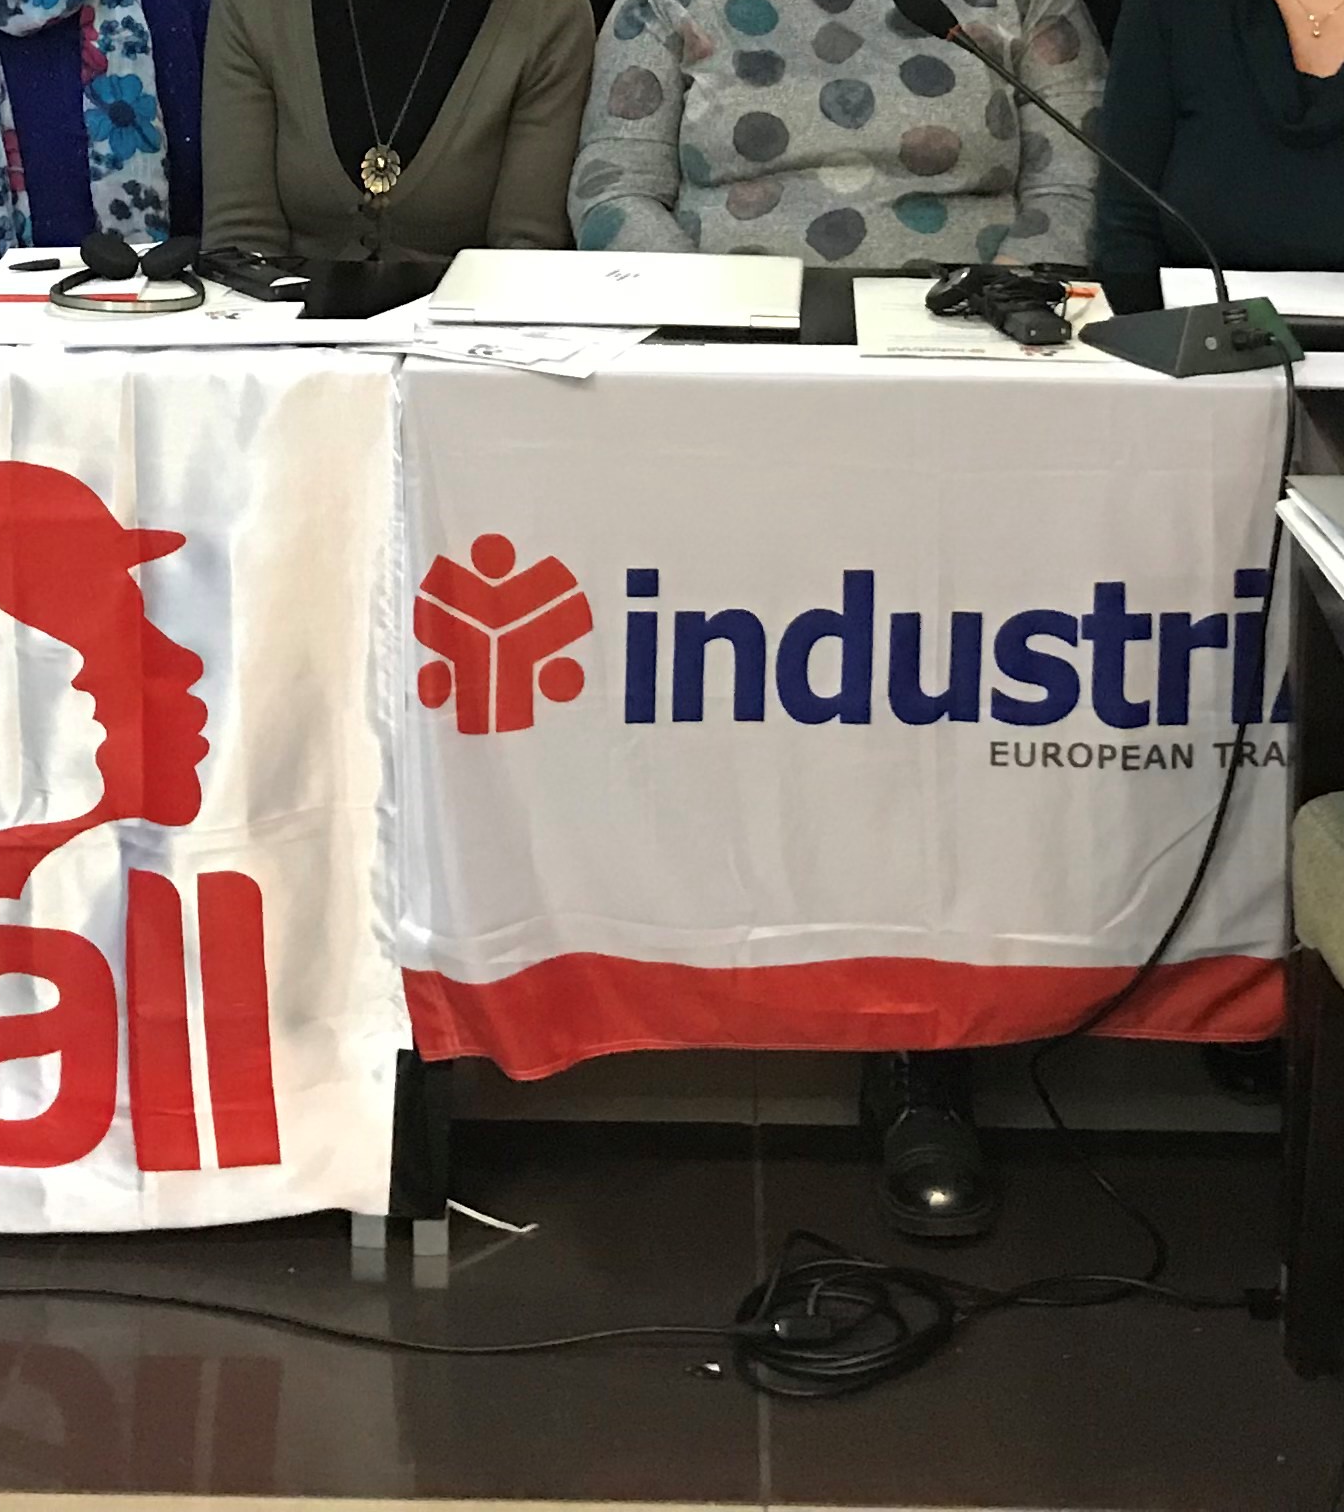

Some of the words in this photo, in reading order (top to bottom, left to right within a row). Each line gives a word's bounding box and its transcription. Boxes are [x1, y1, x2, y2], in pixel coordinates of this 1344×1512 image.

[624, 568, 1292, 727] industri
[990, 740, 1193, 770] EUROPEAN
[1213, 740, 1287, 768] TRA
